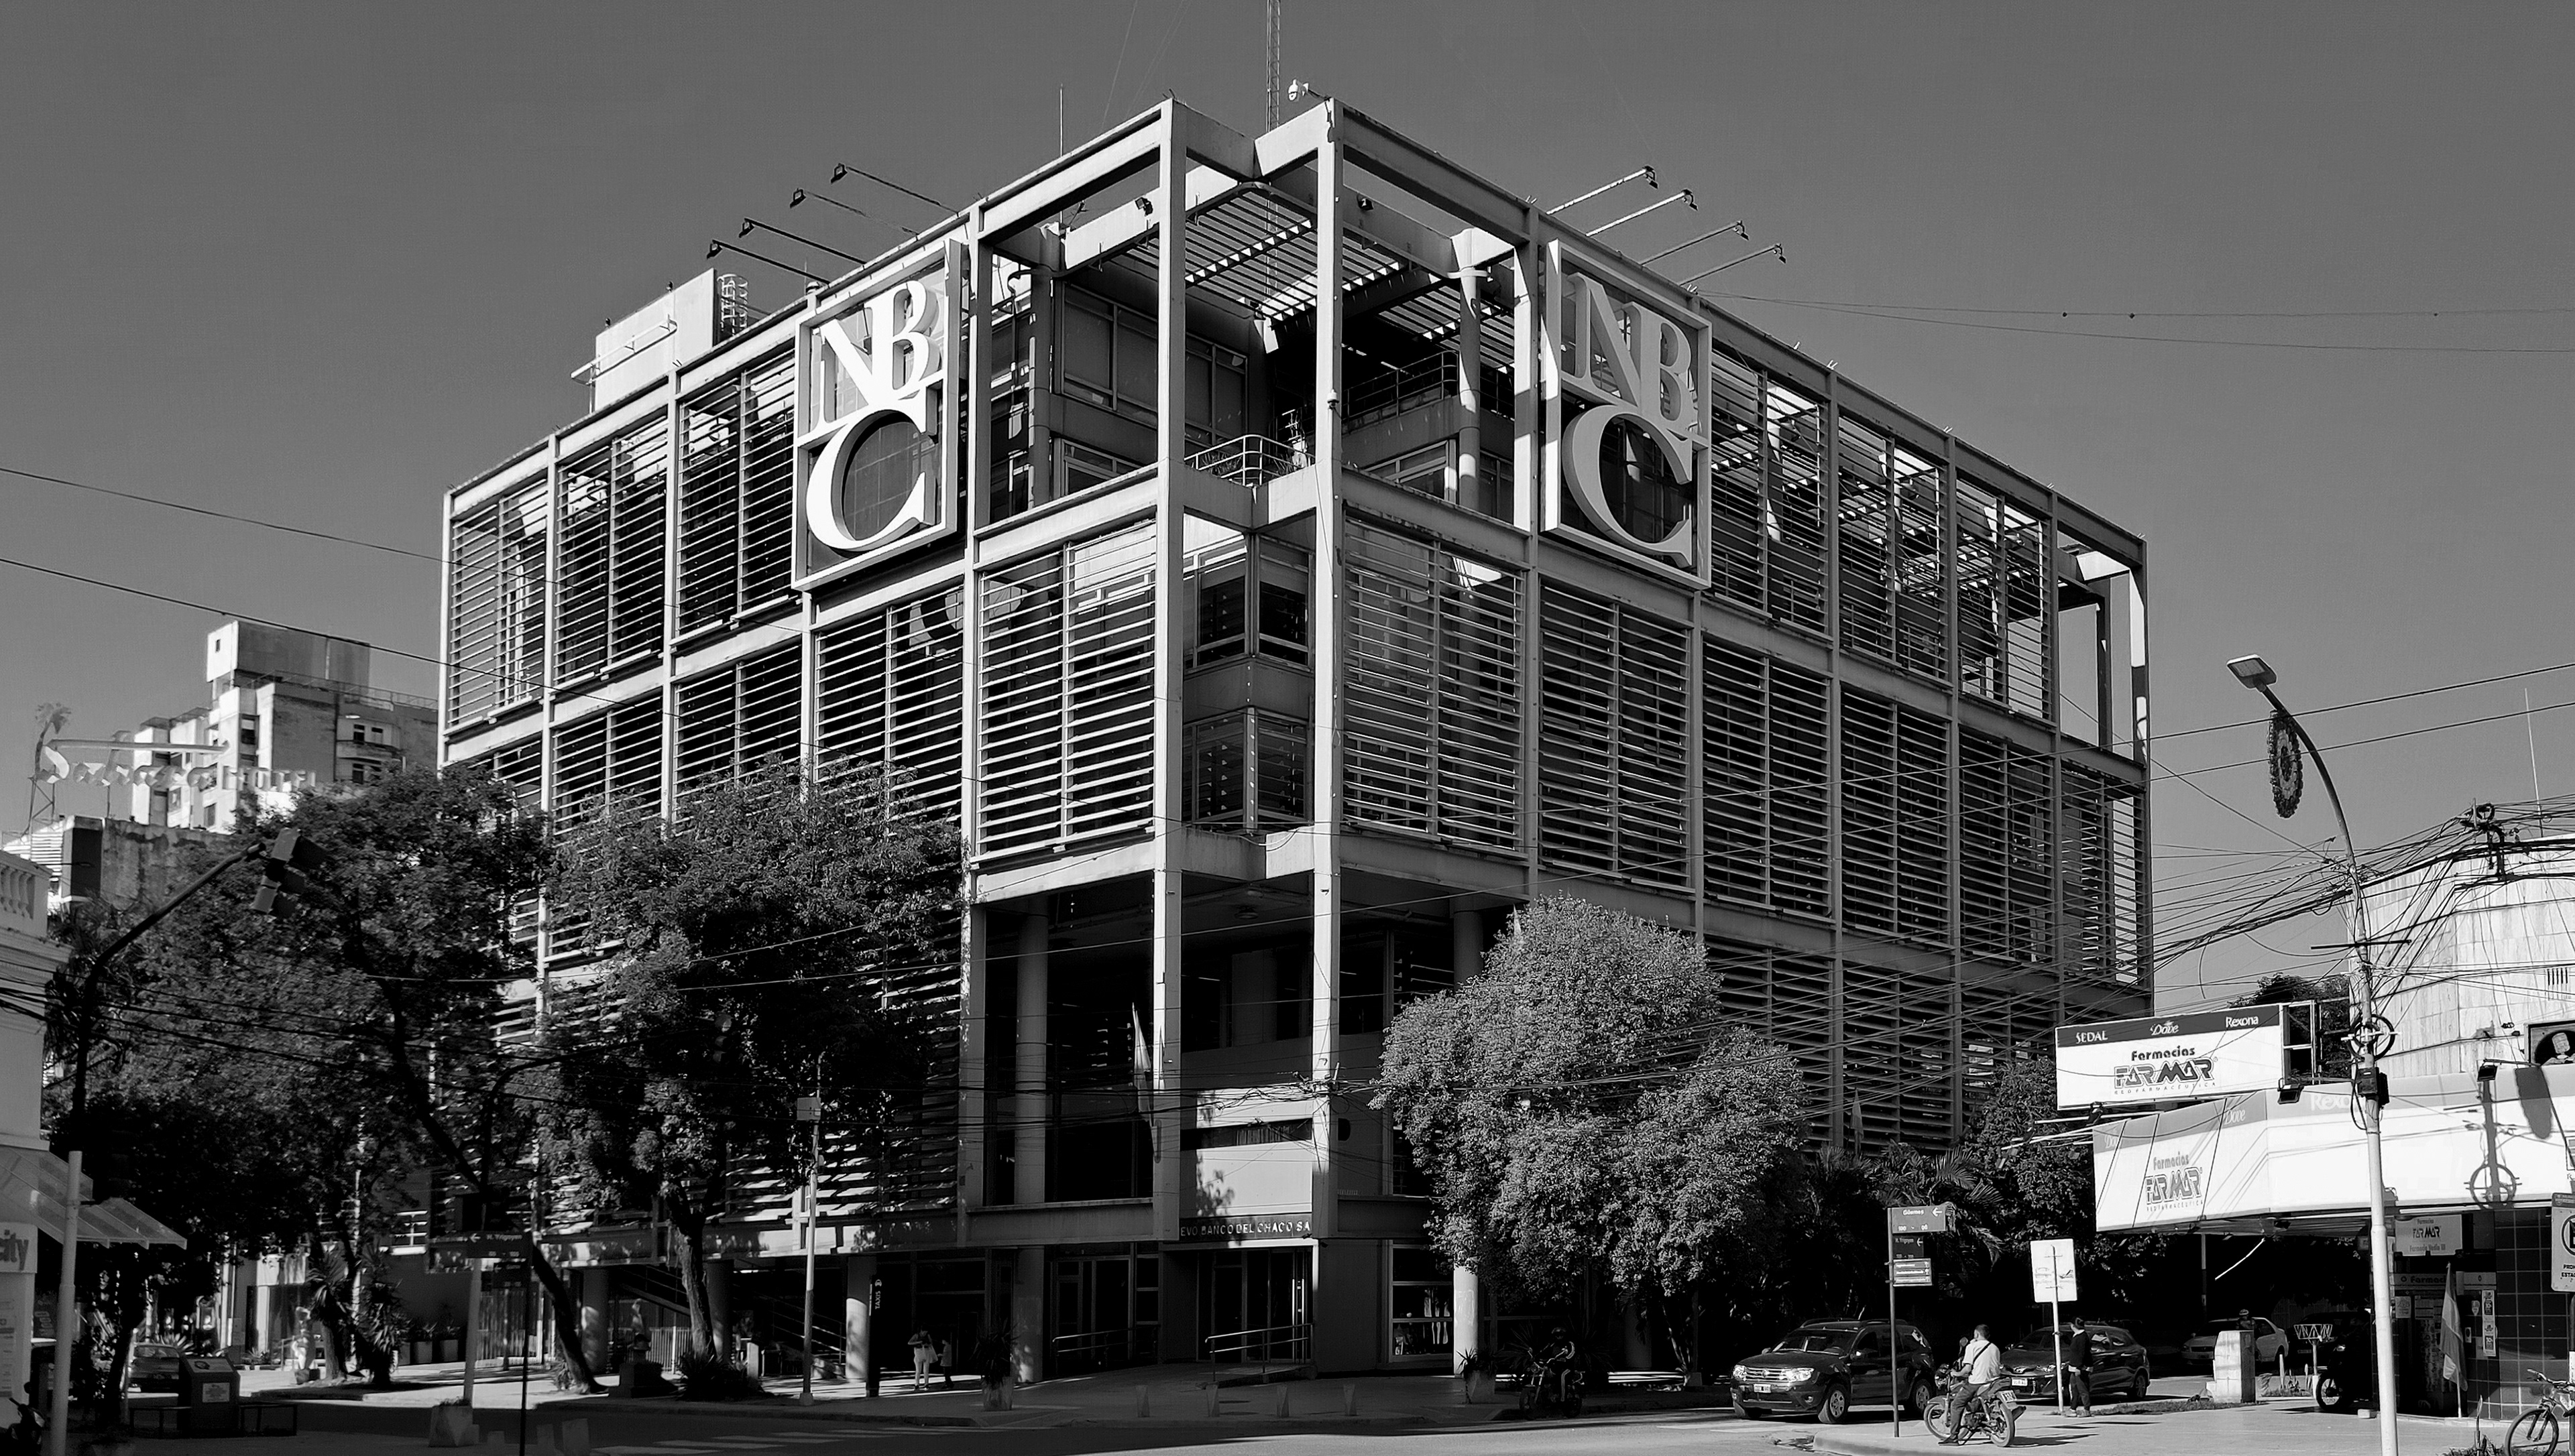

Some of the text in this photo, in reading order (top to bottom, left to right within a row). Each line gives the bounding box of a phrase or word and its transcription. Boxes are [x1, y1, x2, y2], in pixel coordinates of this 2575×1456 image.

[2075, 1015, 2259, 1044] SEDAL Dove Rexona
[2131, 1045, 2195, 1061] Farmacias
[2114, 1057, 2214, 1089] FARMAR
[2311, 1094, 2352, 1111] Rexo
[2224, 1107, 2246, 1126] Dove
[2153, 1151, 2189, 1170] Farmacias
[1201, 1224, 1233, 1235] BANCO
[1236, 1223, 1255, 1234] DEL
[1257, 1221, 1293, 1233] CHACO
[1296, 1220, 1310, 1232] SA
[2413, 1226, 2440, 1238] FARMAR
